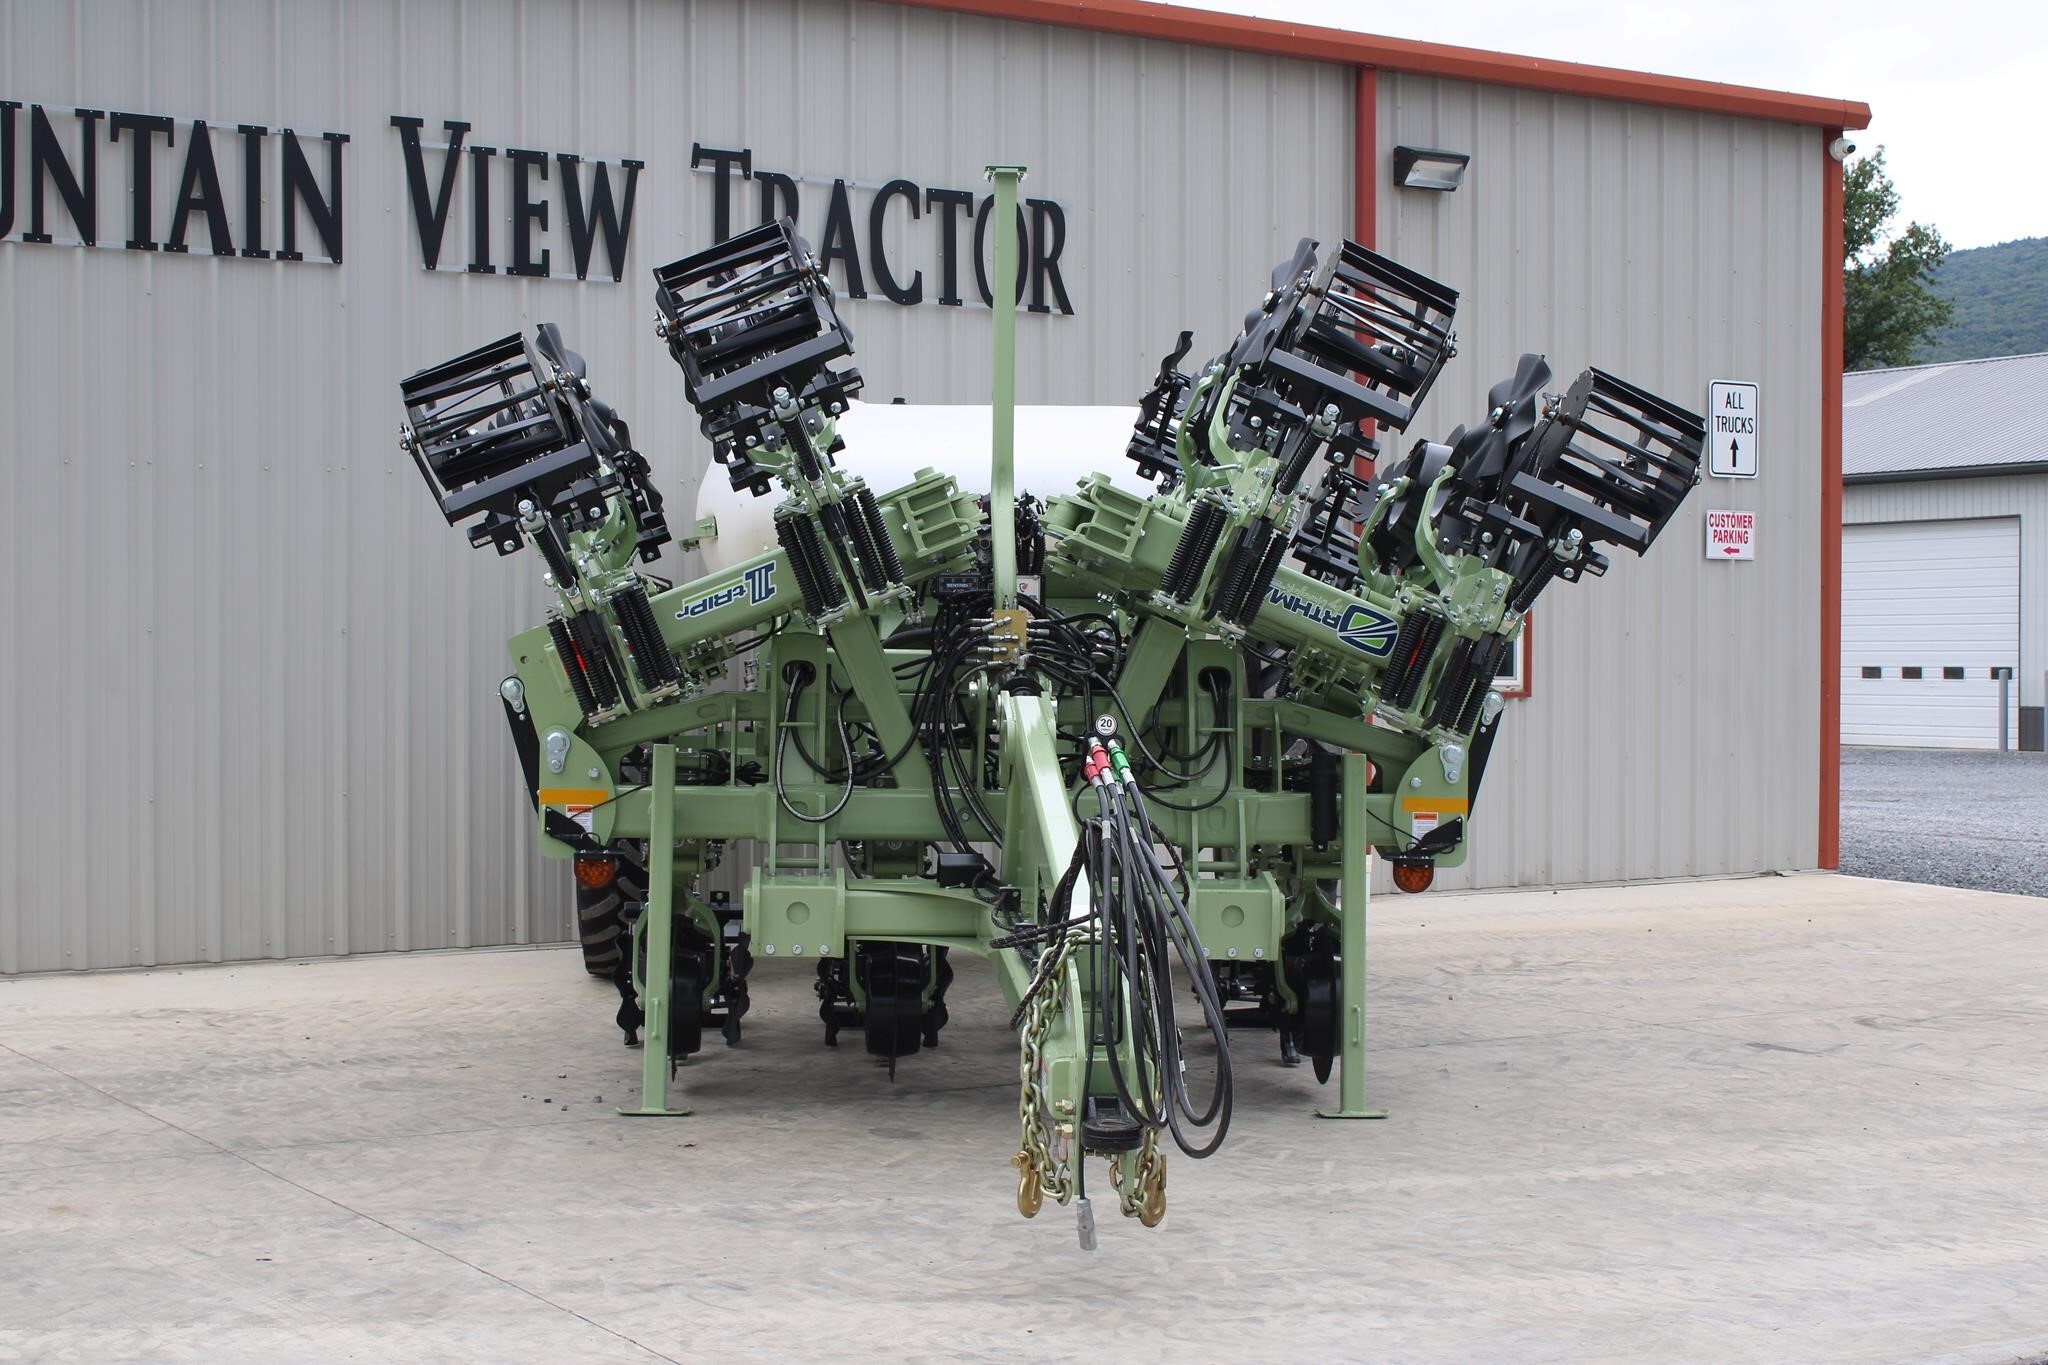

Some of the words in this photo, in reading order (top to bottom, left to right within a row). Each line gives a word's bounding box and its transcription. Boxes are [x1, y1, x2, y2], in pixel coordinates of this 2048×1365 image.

[390, 116, 644, 282] VIEW
[1725, 392, 1744, 410] ALL
[1715, 415, 1754, 434] TRUCKS
[1708, 513, 1753, 529] CUSTOMER
[1712, 529, 1749, 545] PARKING
[1100, 718, 1113, 728] 20
